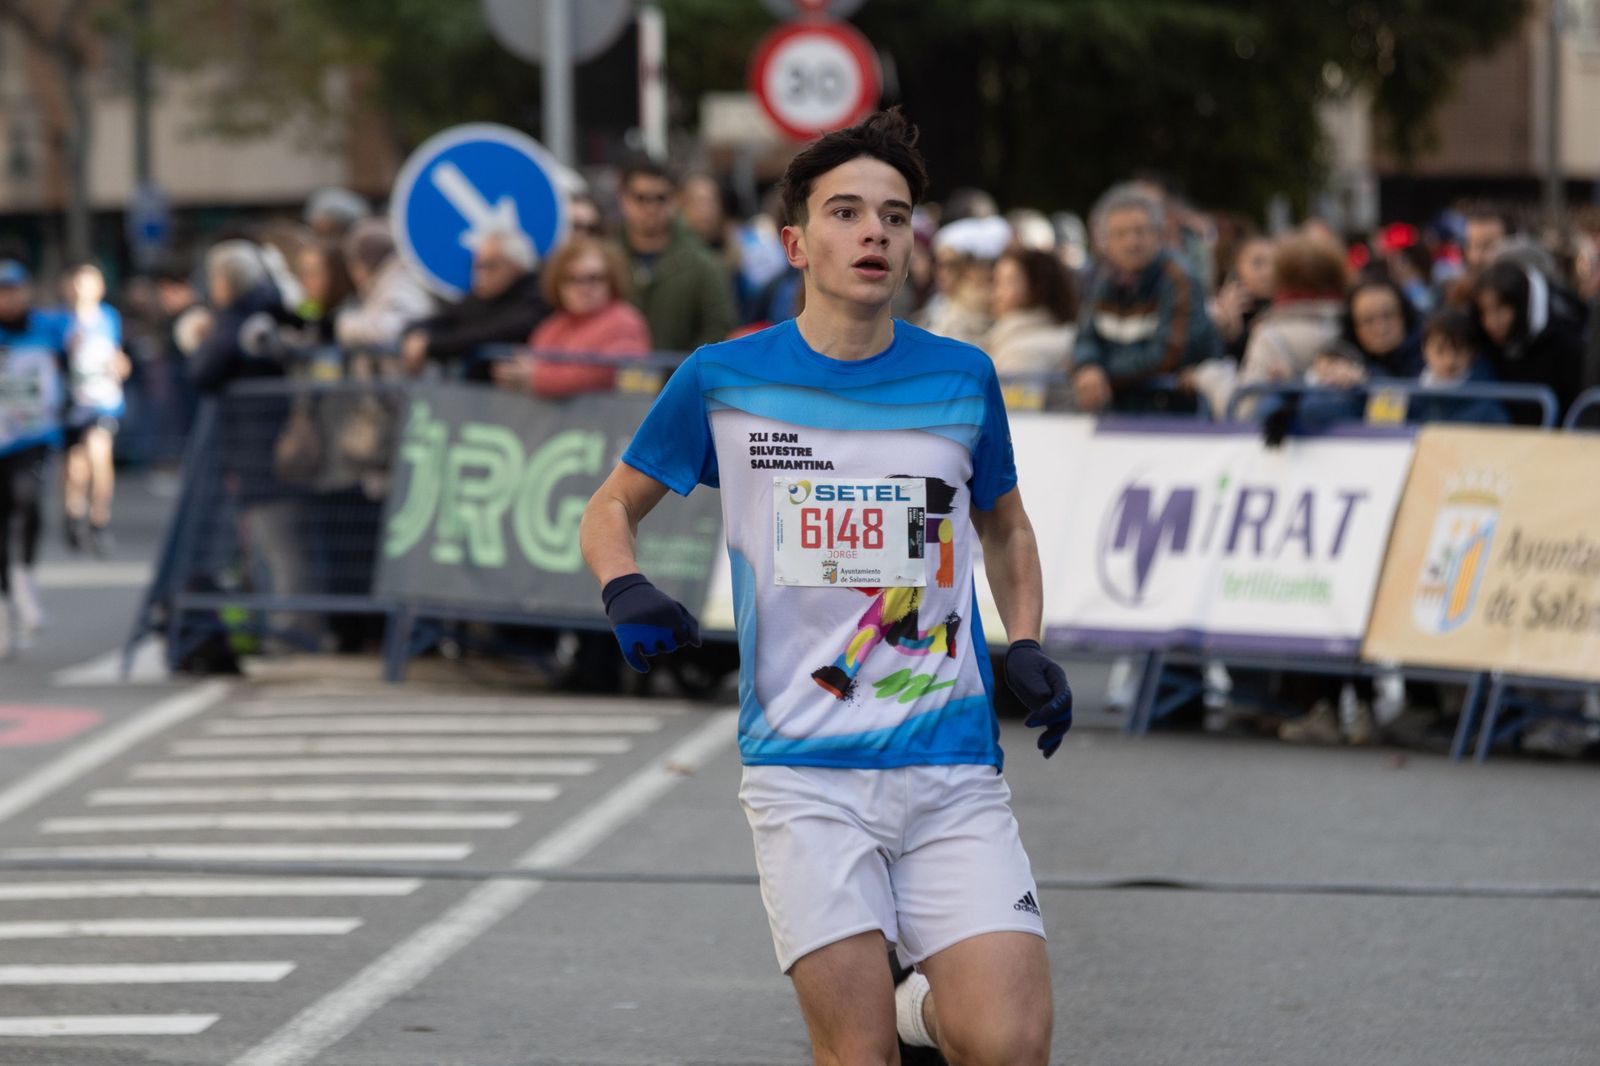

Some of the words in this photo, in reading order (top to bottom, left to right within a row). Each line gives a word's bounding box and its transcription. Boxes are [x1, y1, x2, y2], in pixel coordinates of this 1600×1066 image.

[785, 60, 848, 105] 30
[748, 432, 769, 443] XLI
[772, 432, 798, 444] SAN
[749, 445, 812, 457] SILVESTRE
[750, 459, 835, 471] SALMANTINA
[383, 401, 606, 572] JRG
[815, 484, 911, 502] SETEL
[801, 507, 884, 550] 6148
[827, 550, 858, 559] JORGE
[840, 567, 881, 576] Ayuntamiento
[840, 575, 848, 583] de
[849, 575, 881, 583] Salamanca
